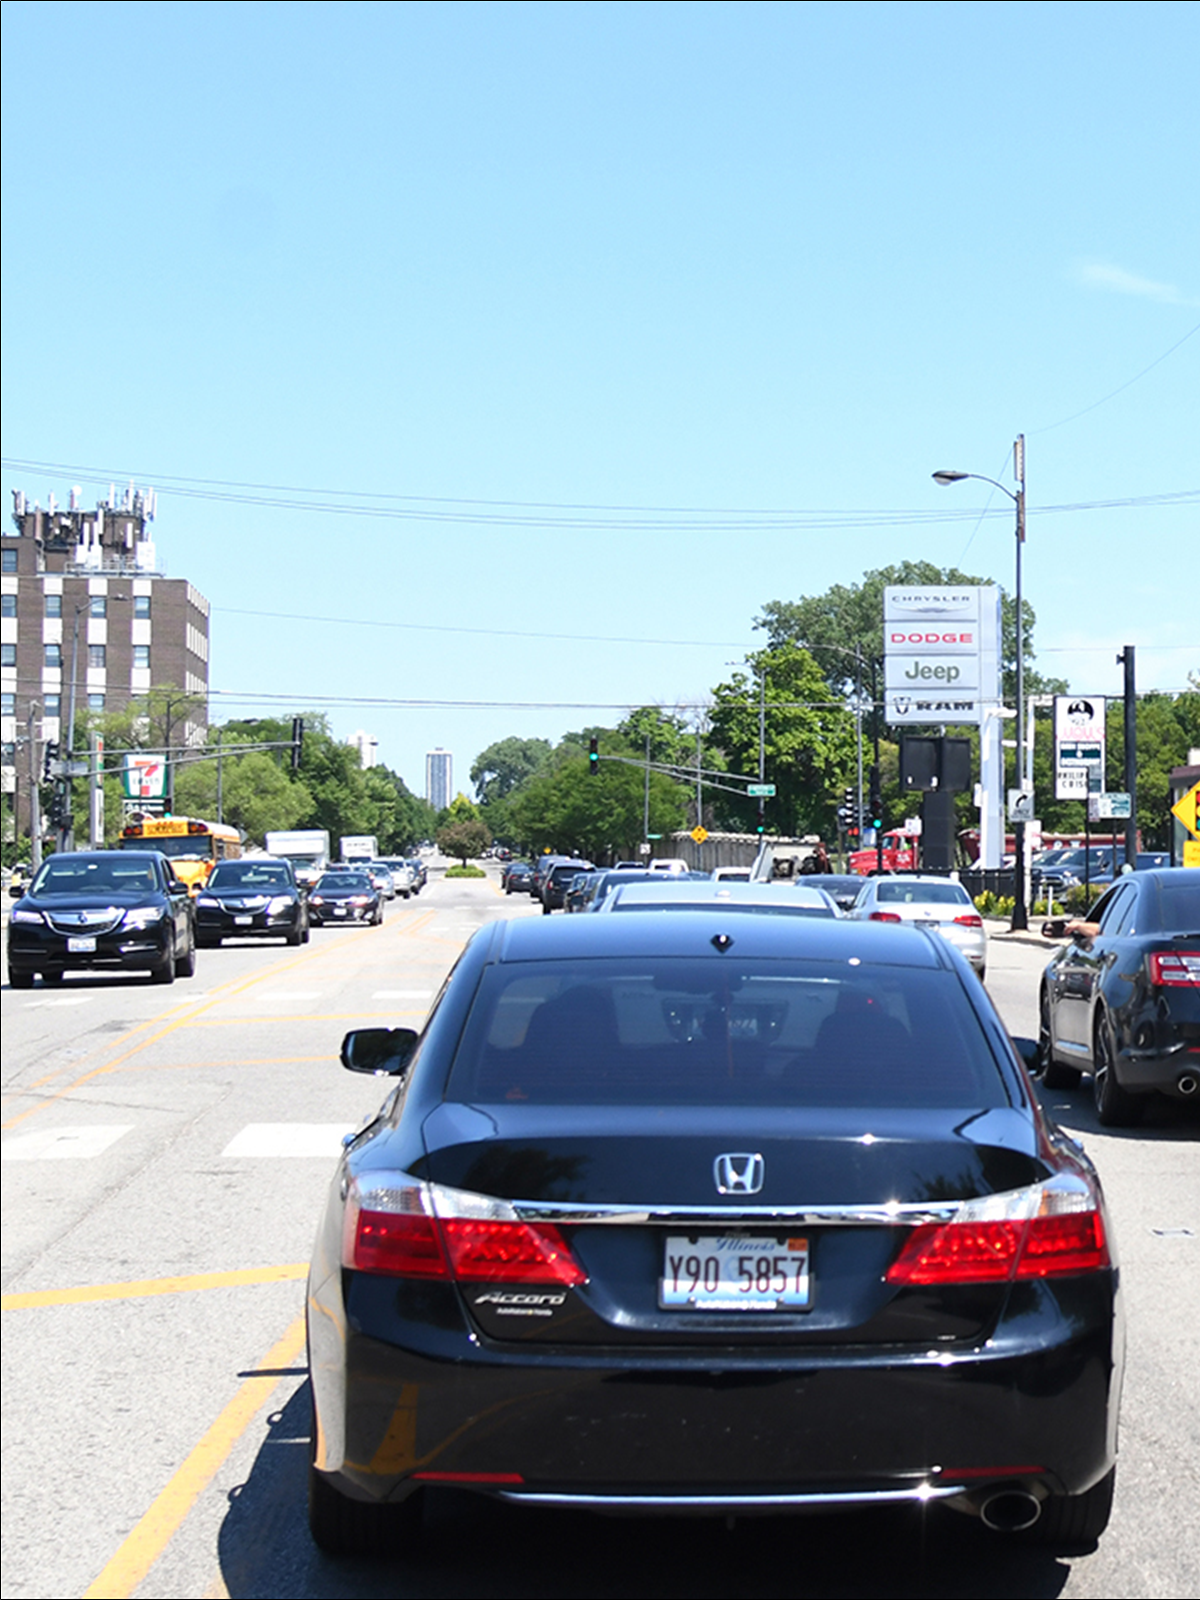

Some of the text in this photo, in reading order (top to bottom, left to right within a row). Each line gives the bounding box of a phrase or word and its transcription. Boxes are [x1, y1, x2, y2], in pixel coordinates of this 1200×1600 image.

[892, 595, 970, 603] CHRYSLER
[891, 632, 974, 644] DODGE
[904, 660, 960, 684] Jeep
[916, 700, 974, 711] RAM
[669, 1255, 806, 1294] Y90 5857
[474, 1291, 567, 1305] Accord
